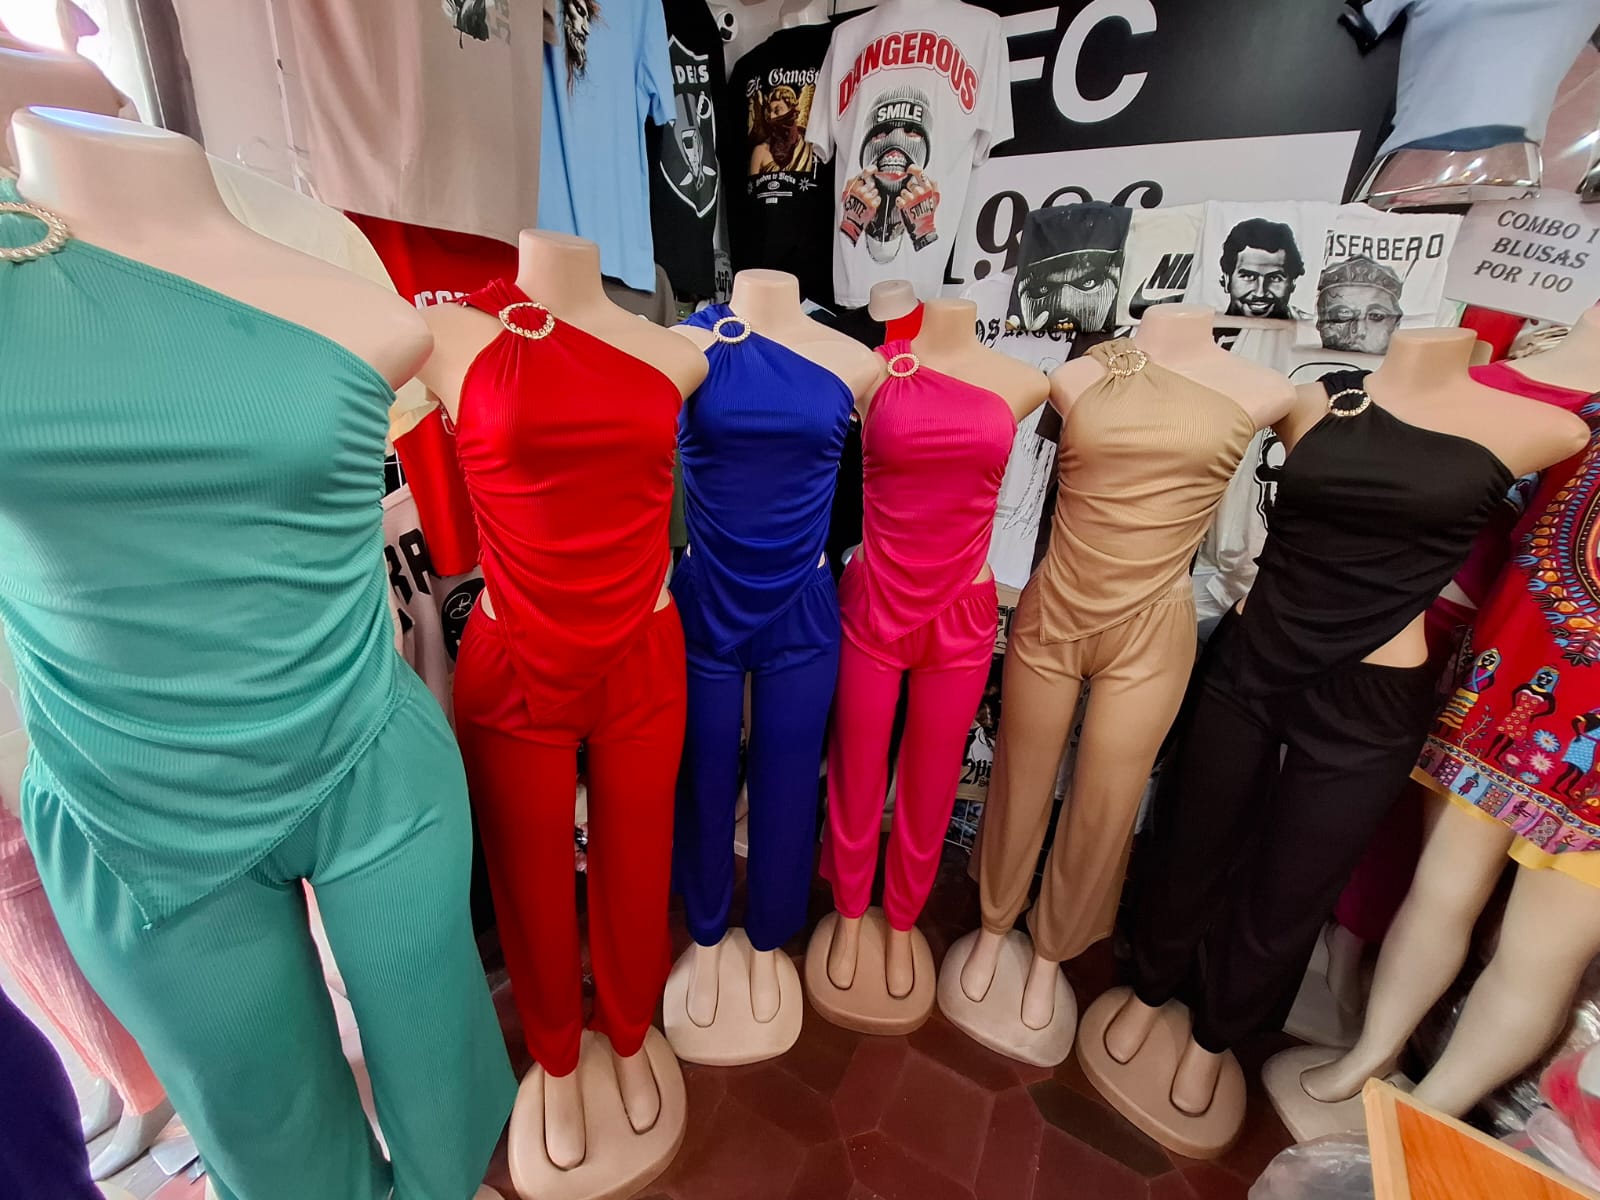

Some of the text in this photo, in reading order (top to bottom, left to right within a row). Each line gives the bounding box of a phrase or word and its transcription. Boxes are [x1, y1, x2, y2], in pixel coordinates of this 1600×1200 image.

[674, 64, 710, 84] DES
[838, 30, 979, 117] DANGEROUS
[877, 102, 923, 122] SMILE
[1497, 209, 1581, 240] COMBO
[1491, 237, 1590, 269] BLUSAS
[1473, 260, 1574, 293] POR 100
